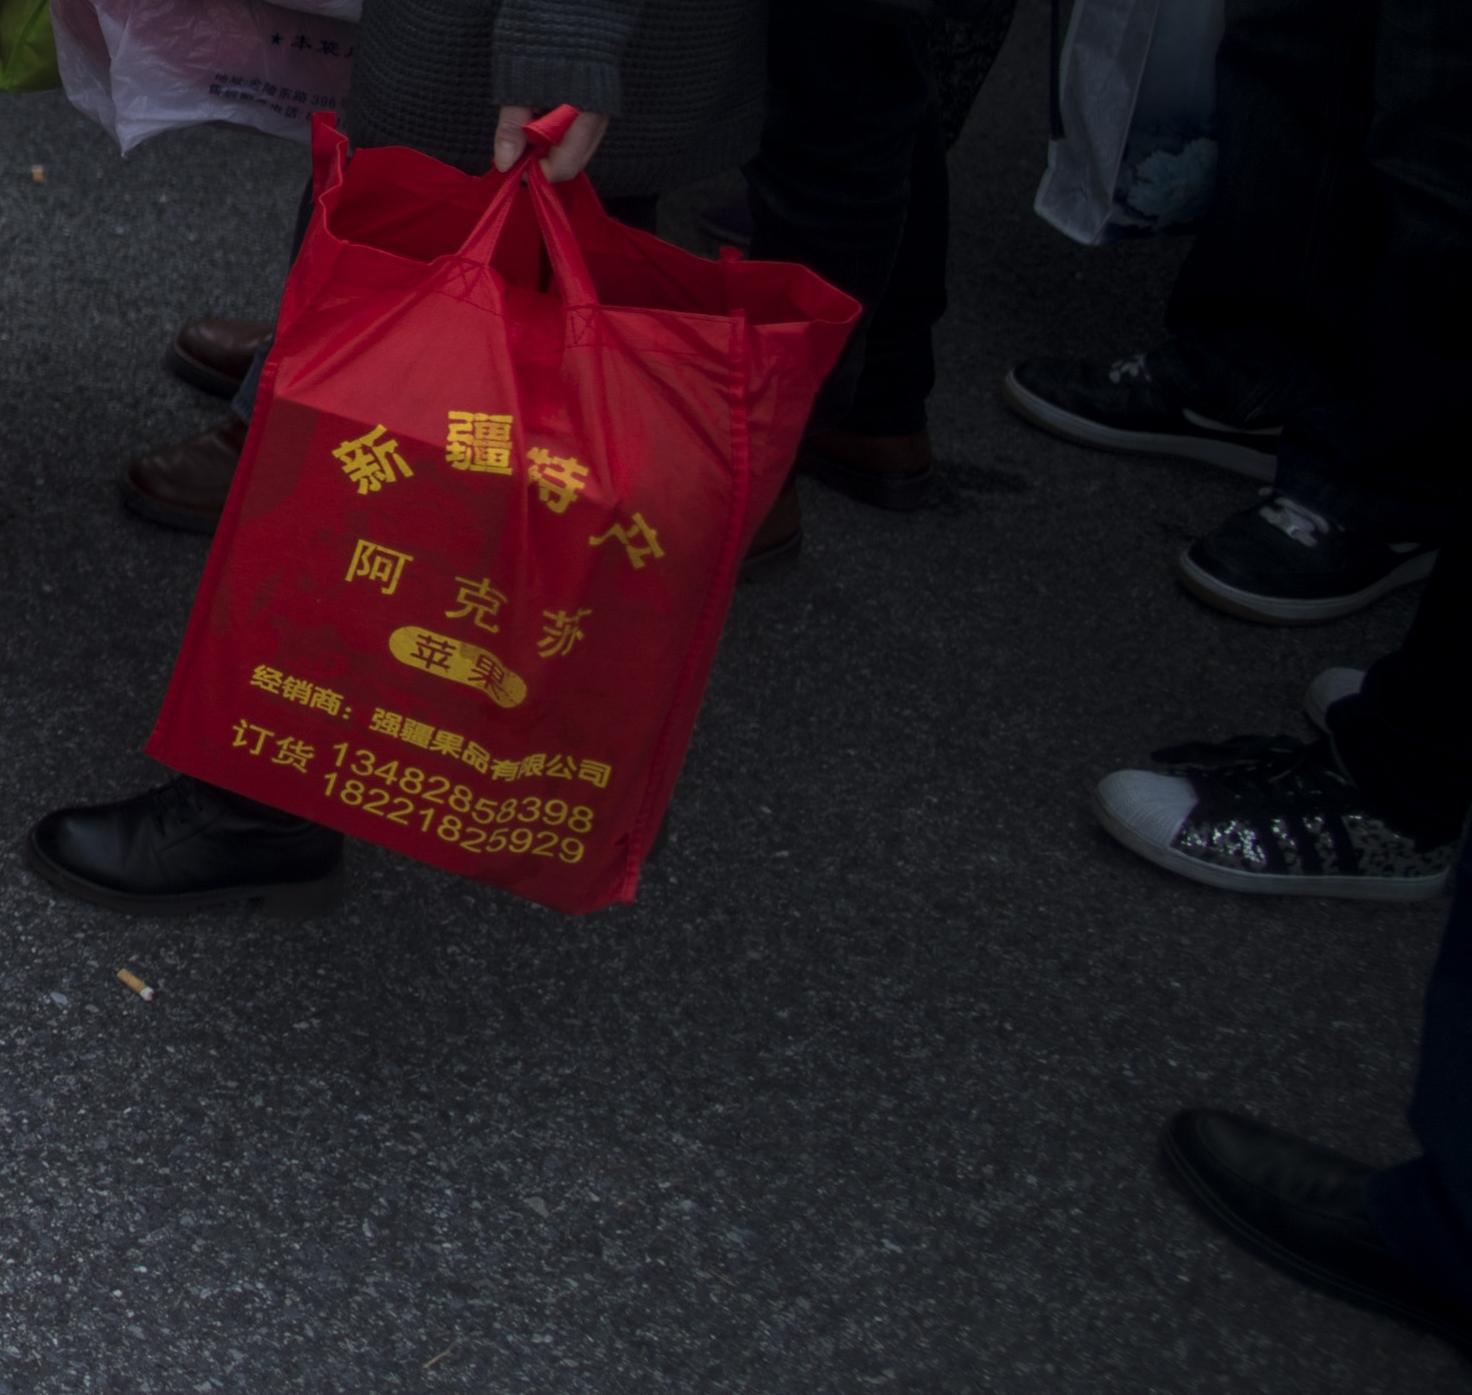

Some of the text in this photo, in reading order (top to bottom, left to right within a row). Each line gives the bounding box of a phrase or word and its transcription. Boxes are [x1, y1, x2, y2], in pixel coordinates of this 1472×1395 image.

[331, 410, 666, 570] 新疆特产
[344, 539, 592, 659] 阿克苏
[410, 633, 508, 702] 苹果
[231, 718, 595, 834] 订货 13482858398
[368, 707, 613, 789] 强疆果品有限公司
[322, 772, 586, 865] 18221825929
